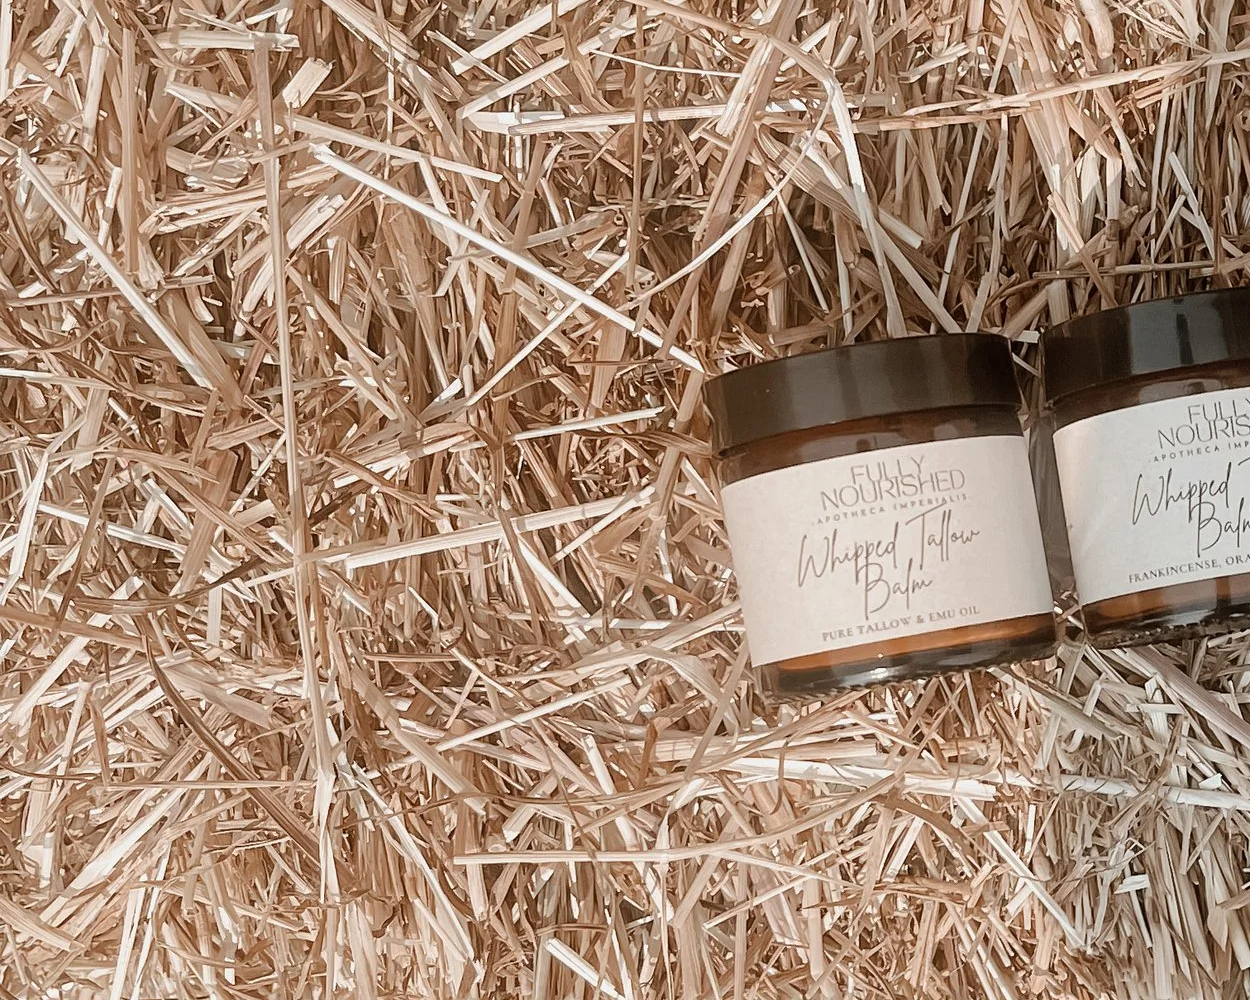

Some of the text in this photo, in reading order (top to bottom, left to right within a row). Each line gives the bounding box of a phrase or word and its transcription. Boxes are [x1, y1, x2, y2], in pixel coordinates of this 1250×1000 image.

[850, 454, 925, 485] FULLY
[1153, 446, 1221, 463] APOTHECA
[816, 493, 968, 524] APOTHECA IMPERIALIS
[820, 469, 966, 512] NOURISHED
[1131, 462, 1232, 525] Whipped
[797, 502, 981, 588] Whipped Tallow
[855, 557, 933, 621] Balm
[1128, 558, 1222, 584] FRANKINCENSE,
[822, 606, 981, 642] PURE TALLOW & EMU OIL
